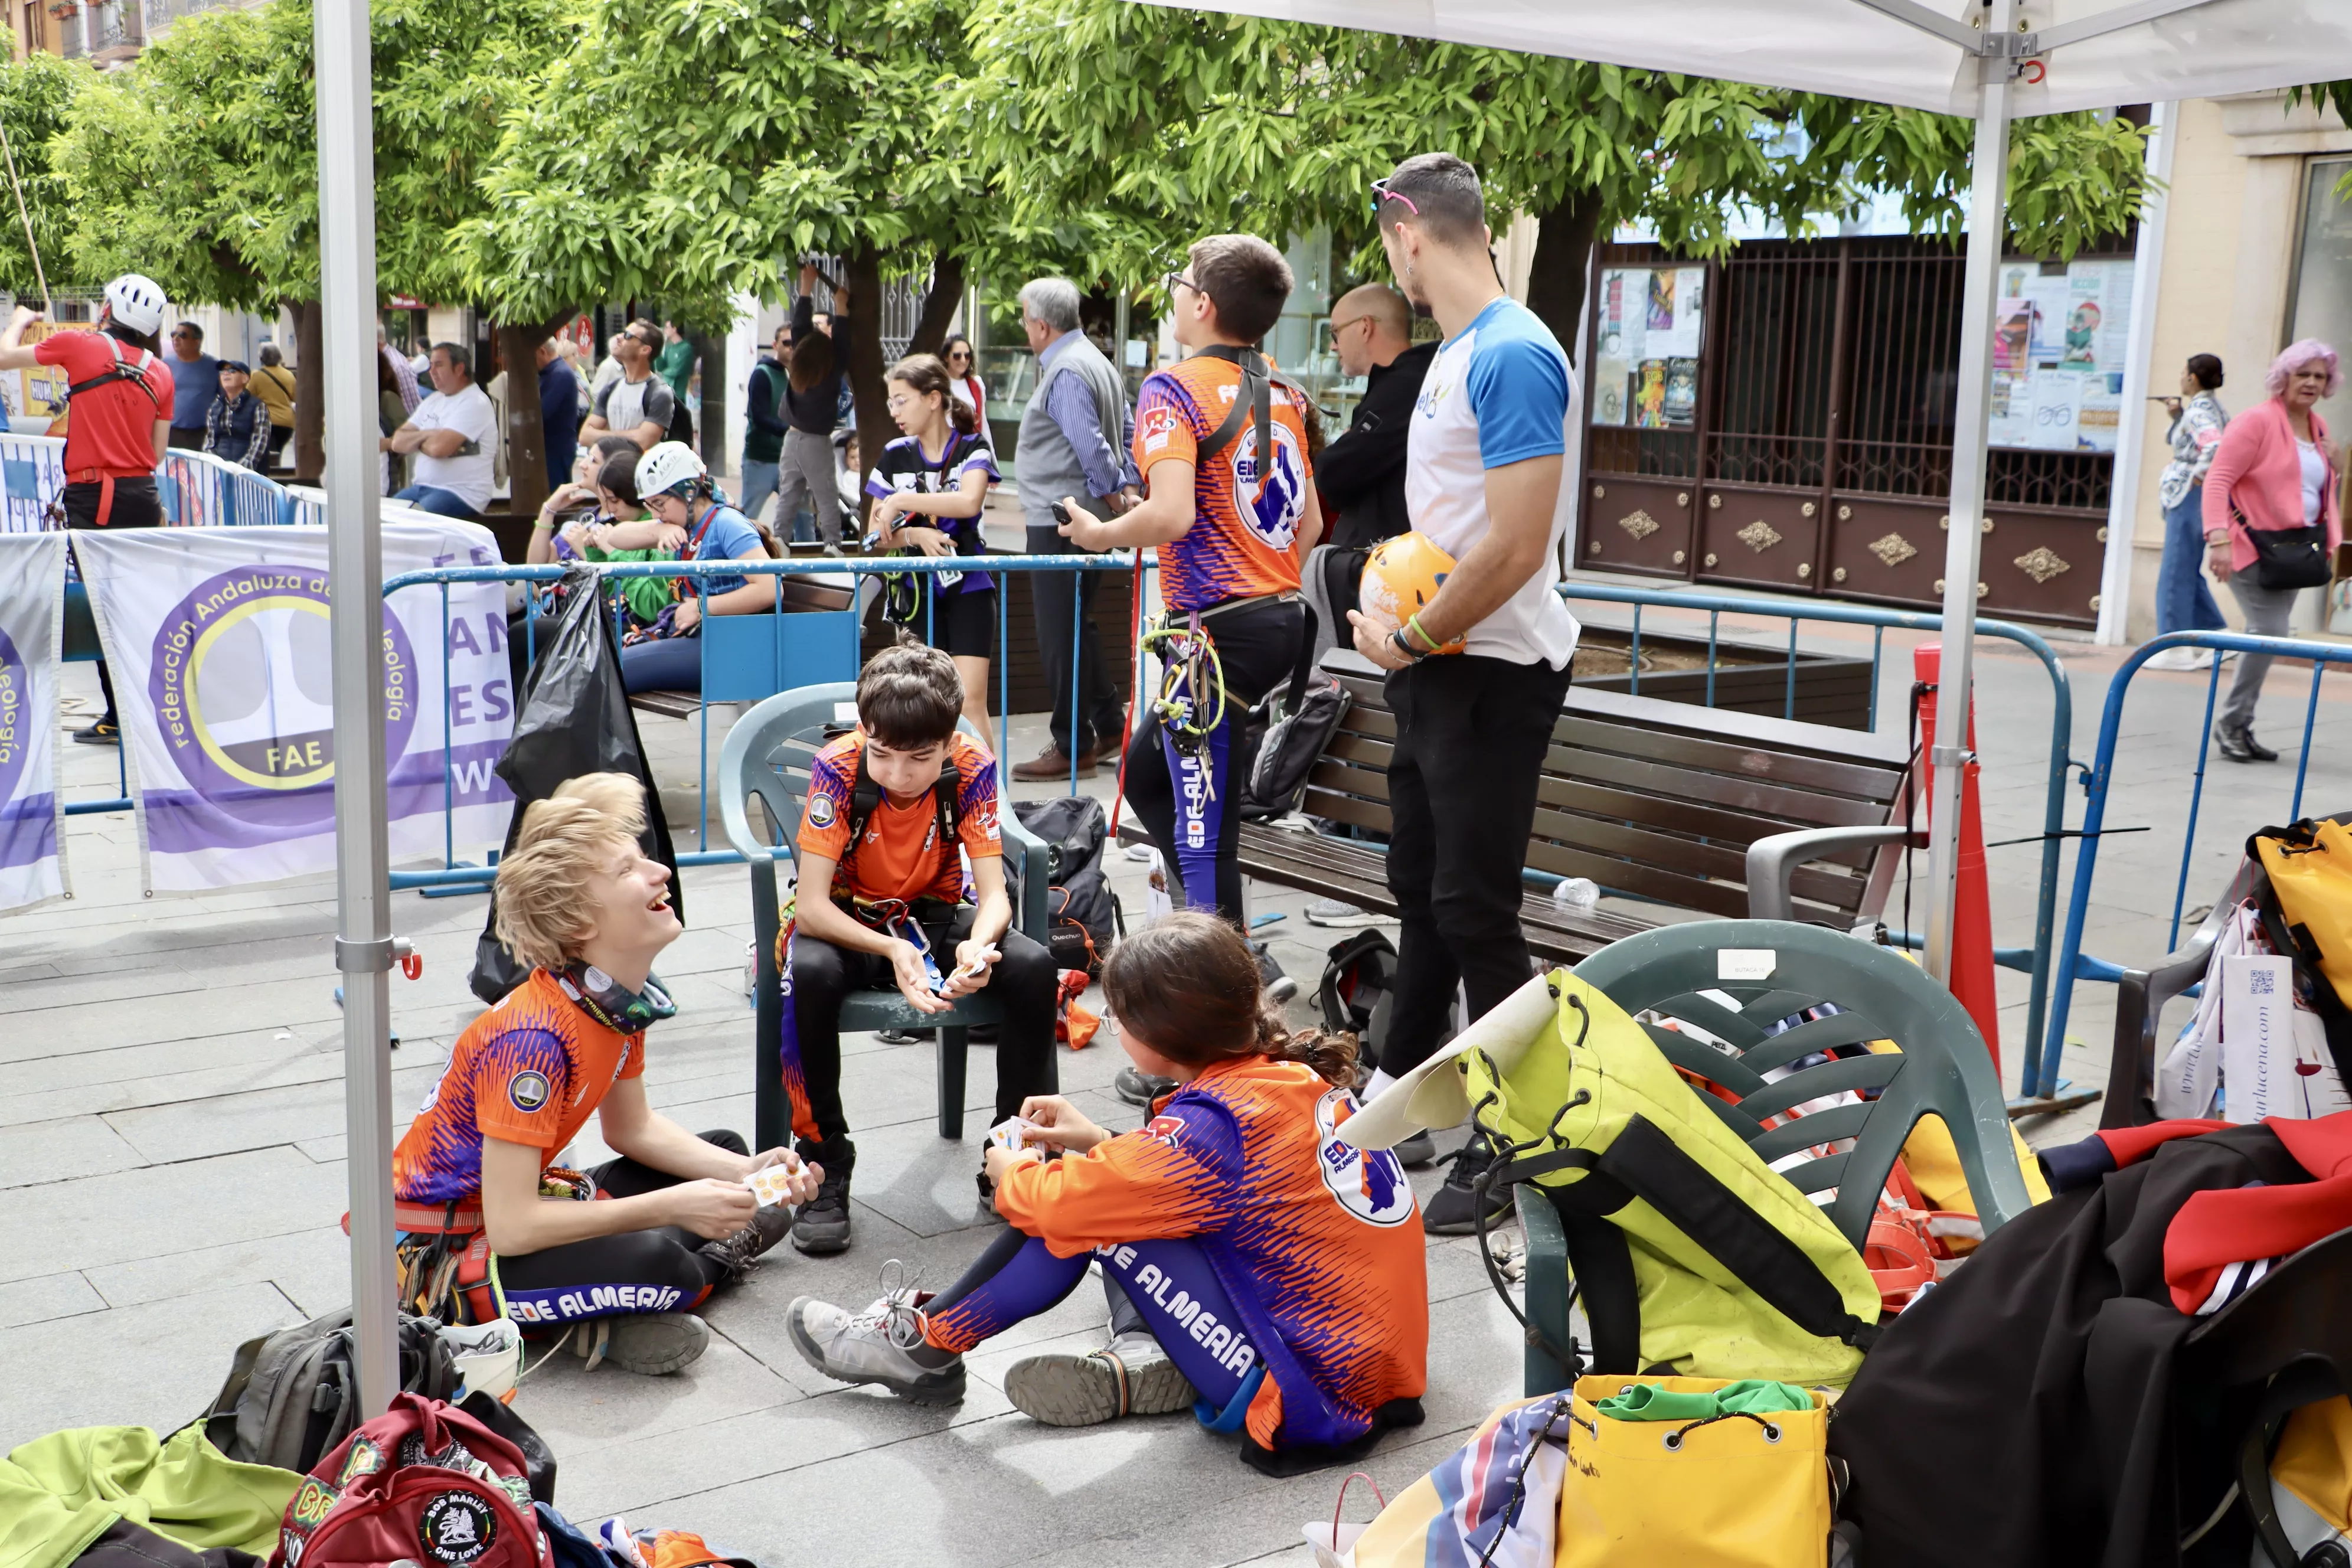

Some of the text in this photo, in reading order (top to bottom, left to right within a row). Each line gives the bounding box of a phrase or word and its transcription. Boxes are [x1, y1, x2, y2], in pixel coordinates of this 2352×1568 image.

[433, 546, 499, 592] FE
[449, 612, 508, 660] AN
[161, 620, 197, 749] Federación
[195, 574, 302, 621] Andaluza
[382, 629, 409, 722] leología
[0, 656, 20, 763] leología
[449, 679, 511, 727] ES
[266, 740, 323, 773] FAE
[451, 757, 494, 795] W
[1186, 805, 1206, 849] EDE
[1051, 933, 1082, 941] Quechua
[1711, 1040, 1727, 1051] PETZL
[2252, 1005, 2269, 1125] turlucena.com
[1324, 1139, 1355, 1165] ED
[1091, 1243, 1138, 1270] DE
[506, 1285, 682, 1322] EDE ALMERÍA
[1134, 1263, 1256, 1378] ALMERÍA
[427, 1494, 489, 1519] BOB MARLEY
[435, 1543, 484, 1561] ONE LOVE
